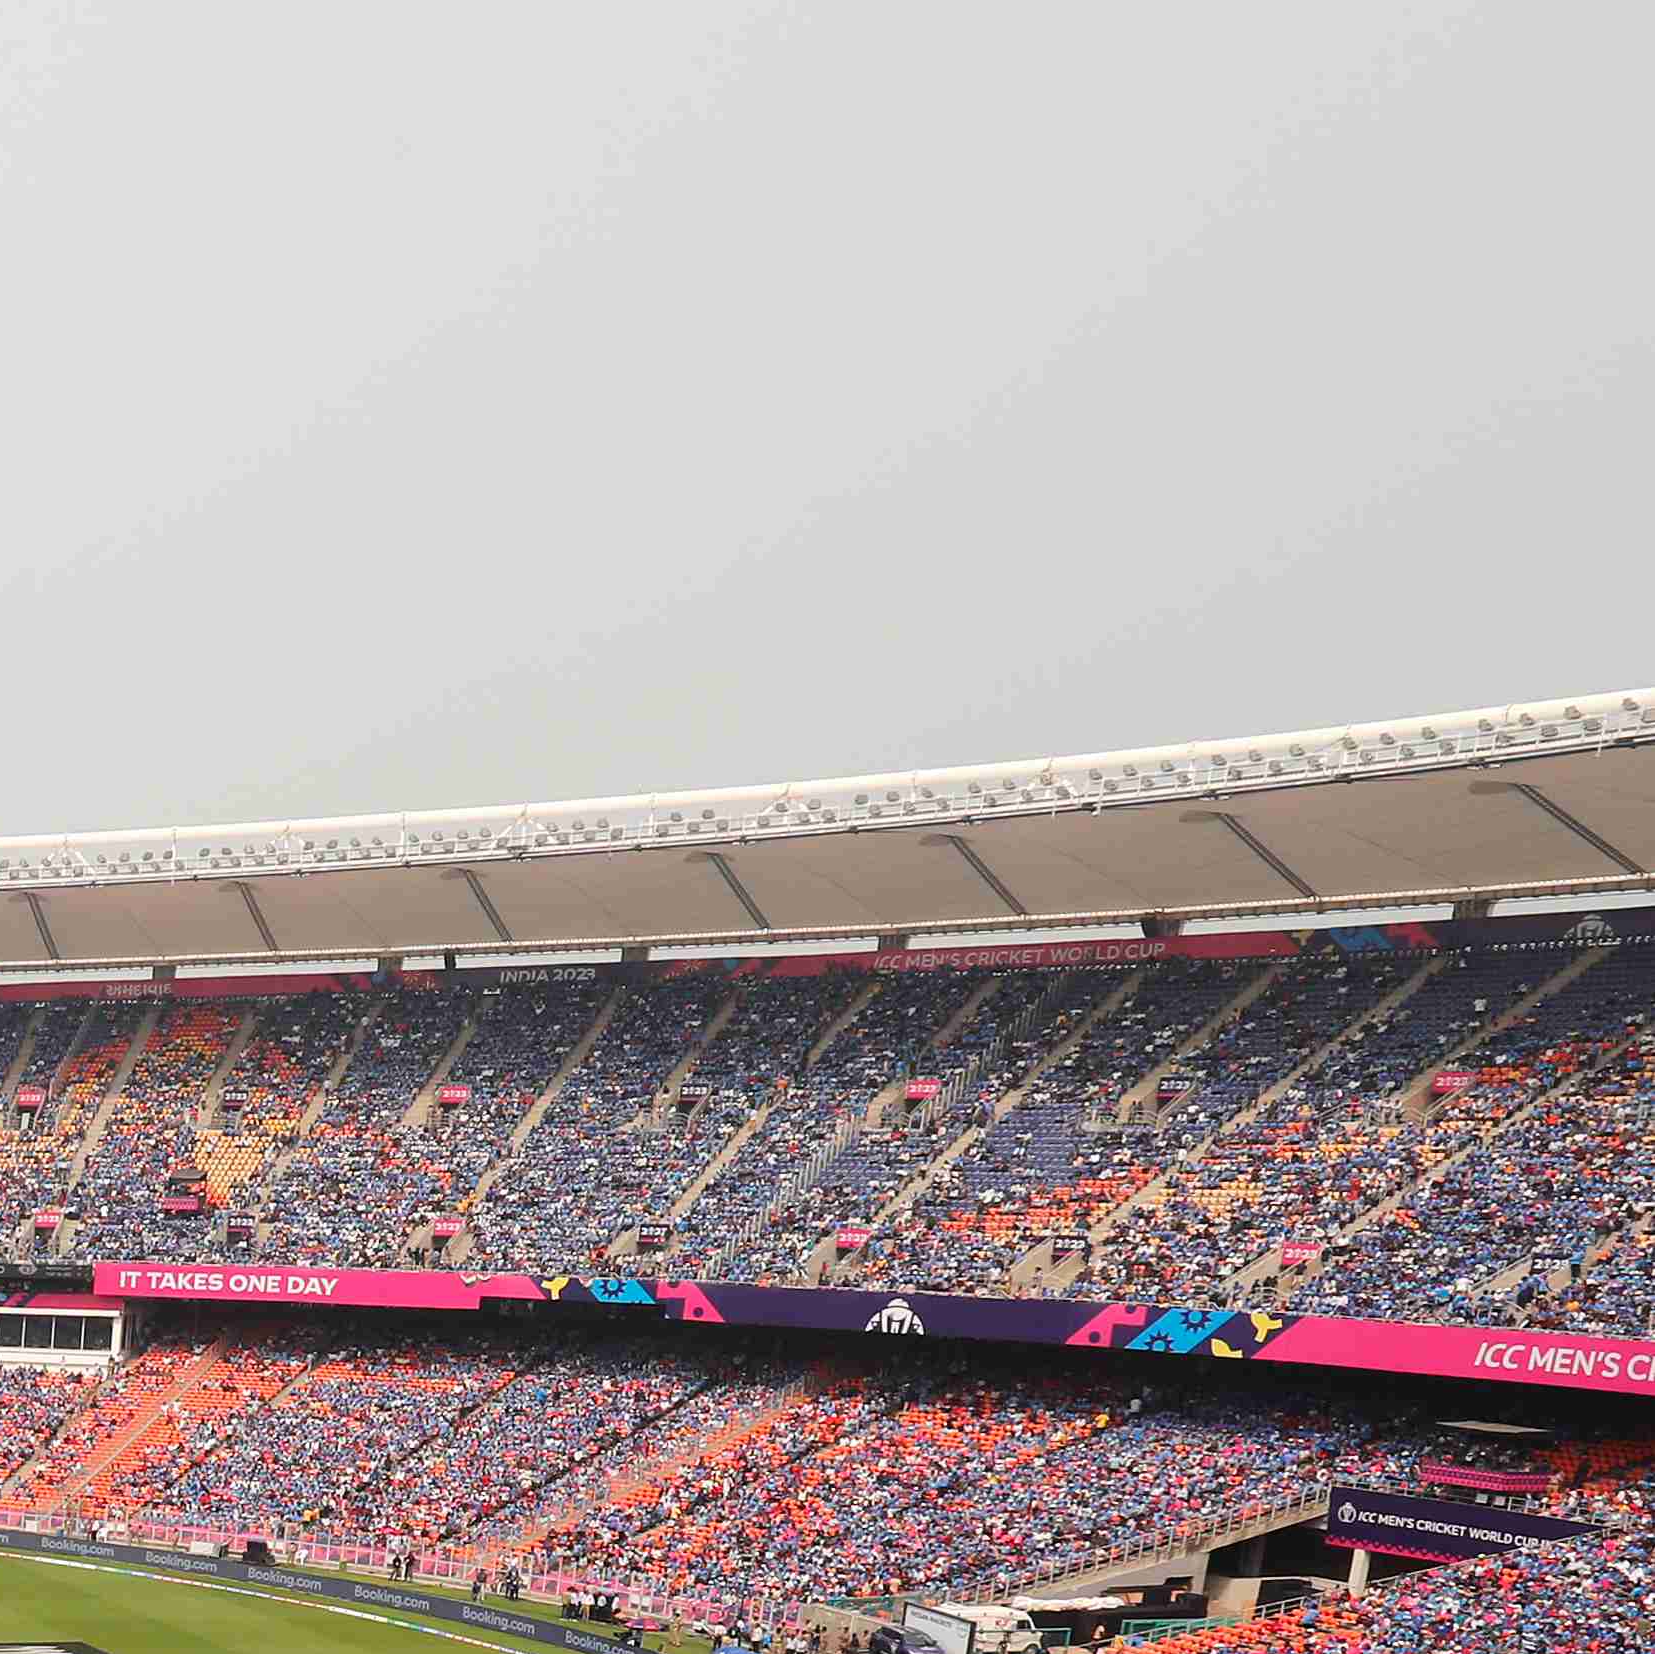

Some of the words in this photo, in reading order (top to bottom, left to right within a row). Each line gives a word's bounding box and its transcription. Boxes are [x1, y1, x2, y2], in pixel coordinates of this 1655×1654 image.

[963, 949, 1043, 967] CRICKET
[1124, 943, 1165, 957] CUP
[118, 1271, 139, 1287] IT
[146, 1271, 224, 1292] TAKES
[227, 1273, 280, 1294] ONE
[286, 1274, 340, 1297] DAY
[1474, 1341, 1526, 1369] ICC
[1527, 1346, 1622, 1379] MEN'S
[1357, 1511, 1378, 1524] ICC
[1377, 1513, 1415, 1530] MEN'S
[1415, 1518, 1468, 1538] CRICKET
[1468, 1526, 1513, 1546] WORLD
[1514, 1533, 1540, 1549] CUP
[40, 1536, 115, 1559] Booking.com
[145, 1551, 218, 1575] Booking.com
[247, 1566, 322, 1594] Booking.com
[354, 1585, 430, 1613] Booking.com
[463, 1605, 536, 1638] Booking.com
